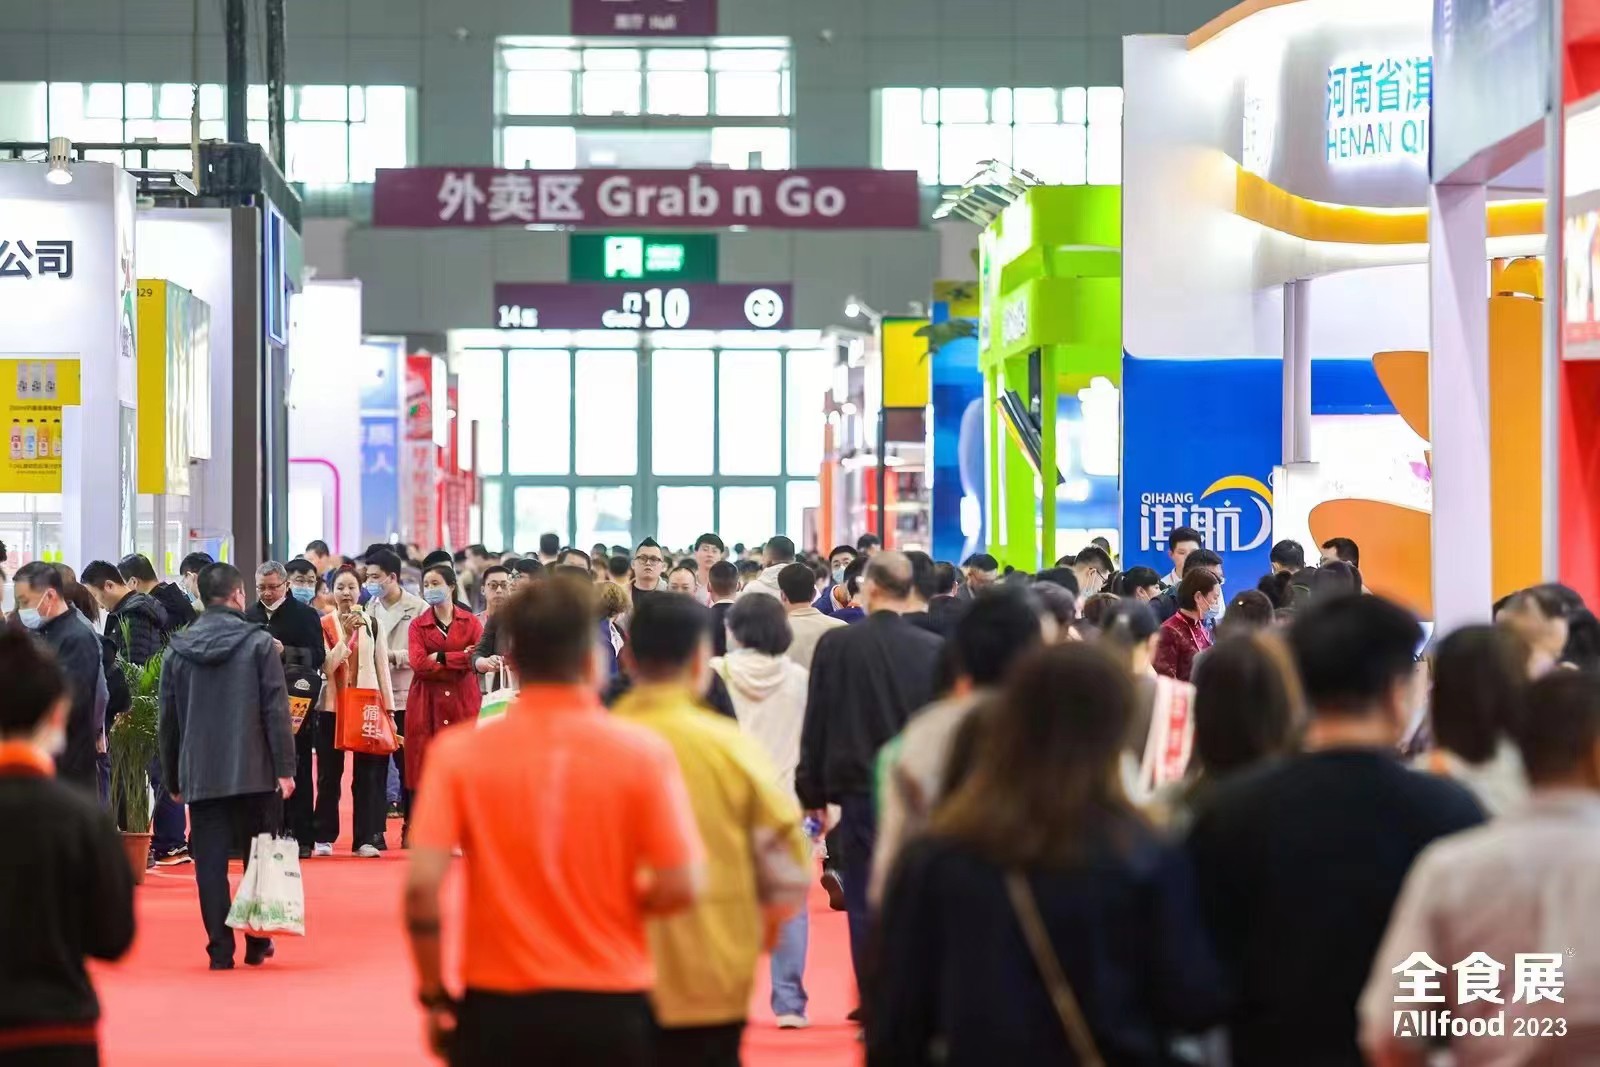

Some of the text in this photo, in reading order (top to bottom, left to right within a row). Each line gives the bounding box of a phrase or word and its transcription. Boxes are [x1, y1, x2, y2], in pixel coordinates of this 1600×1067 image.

[1326, 119, 1425, 161] HENAN QI
[437, 172, 847, 222] 外卖区 Grab n Go
[0, 239, 73, 280] 公司
[1141, 492, 1194, 504] QIHANG
